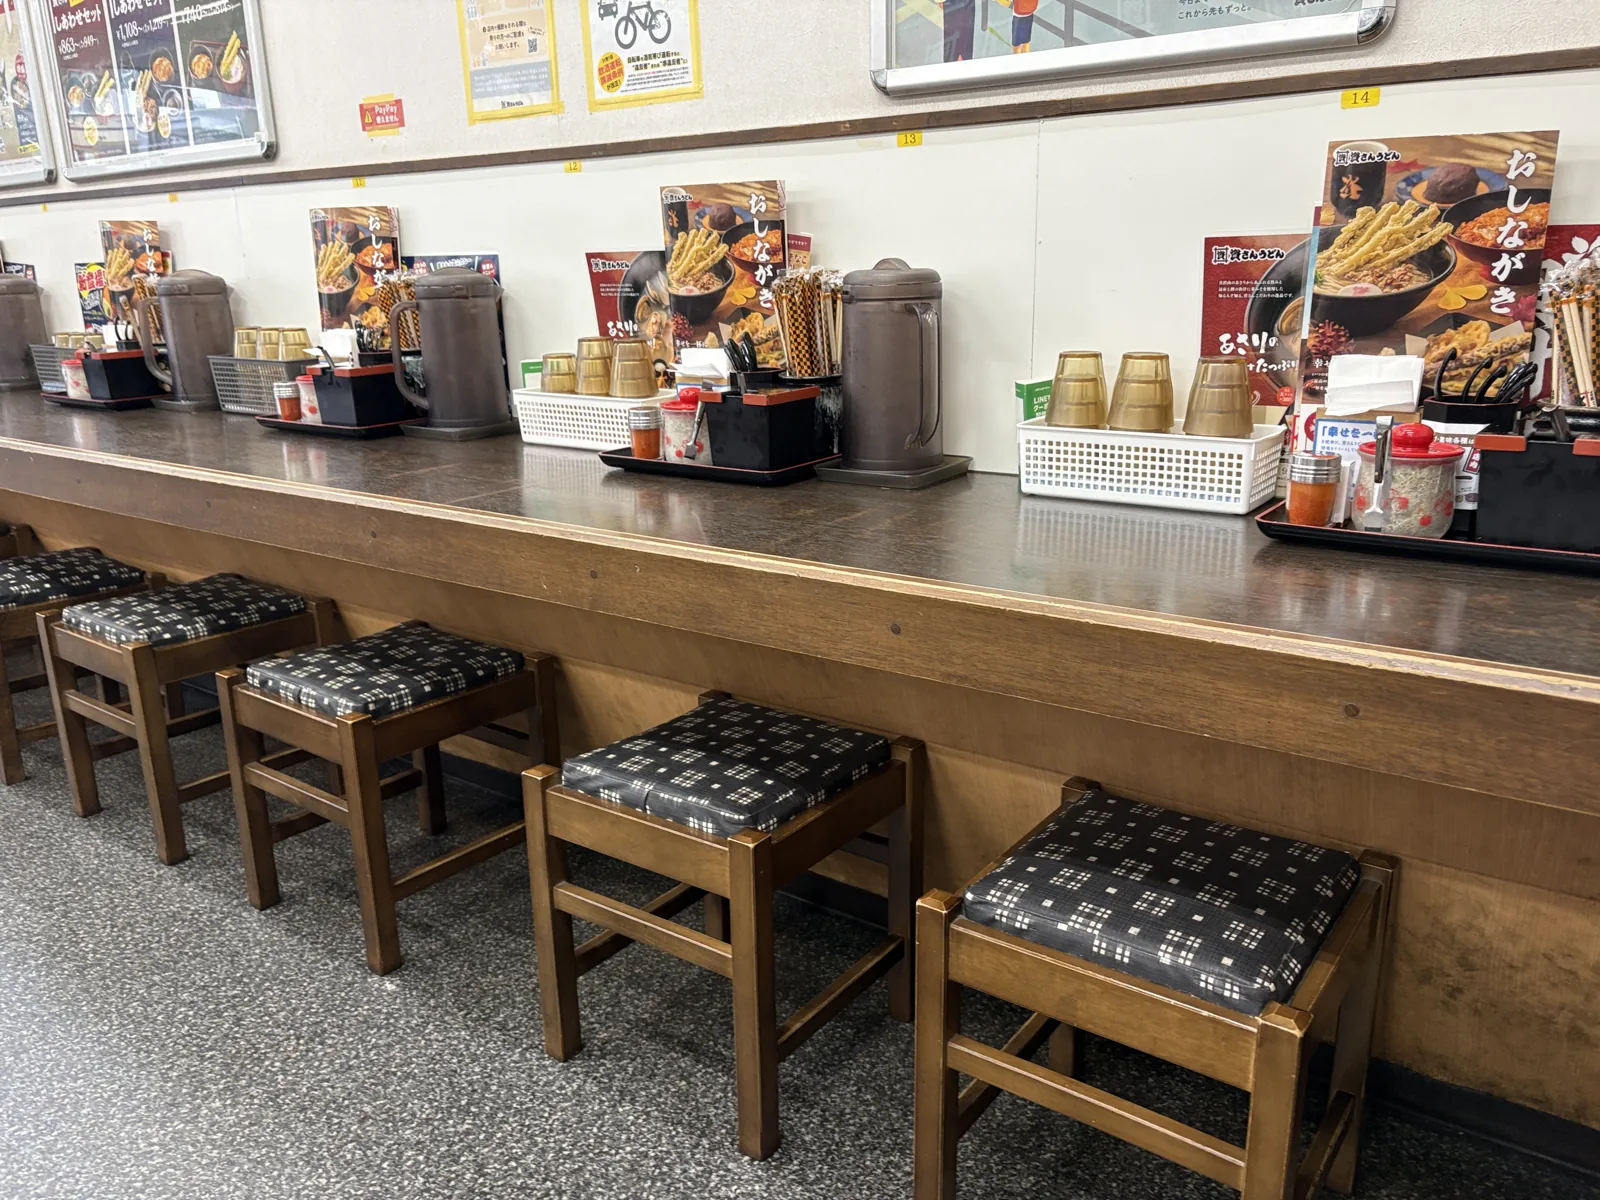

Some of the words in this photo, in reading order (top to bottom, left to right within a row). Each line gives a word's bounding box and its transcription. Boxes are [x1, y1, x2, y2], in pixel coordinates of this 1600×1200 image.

[1178, 3, 1251, 19] これから先もずっと。
[54, 4, 101, 32] しあわせセット
[1352, 91, 1371, 105] 14
[375, 104, 398, 116] PayPay
[376, 115, 399, 124] 使えません
[903, 133, 917, 145] 13
[1350, 152, 1400, 162] 資さんうどん
[568, 162, 578, 171] 12
[354, 179, 363, 187] 11
[1490, 150, 1537, 314] おしながき
[749, 193, 773, 308] おしながき
[1230, 249, 1285, 260] 資さんうどん
[1219, 331, 1279, 356] あさりの
